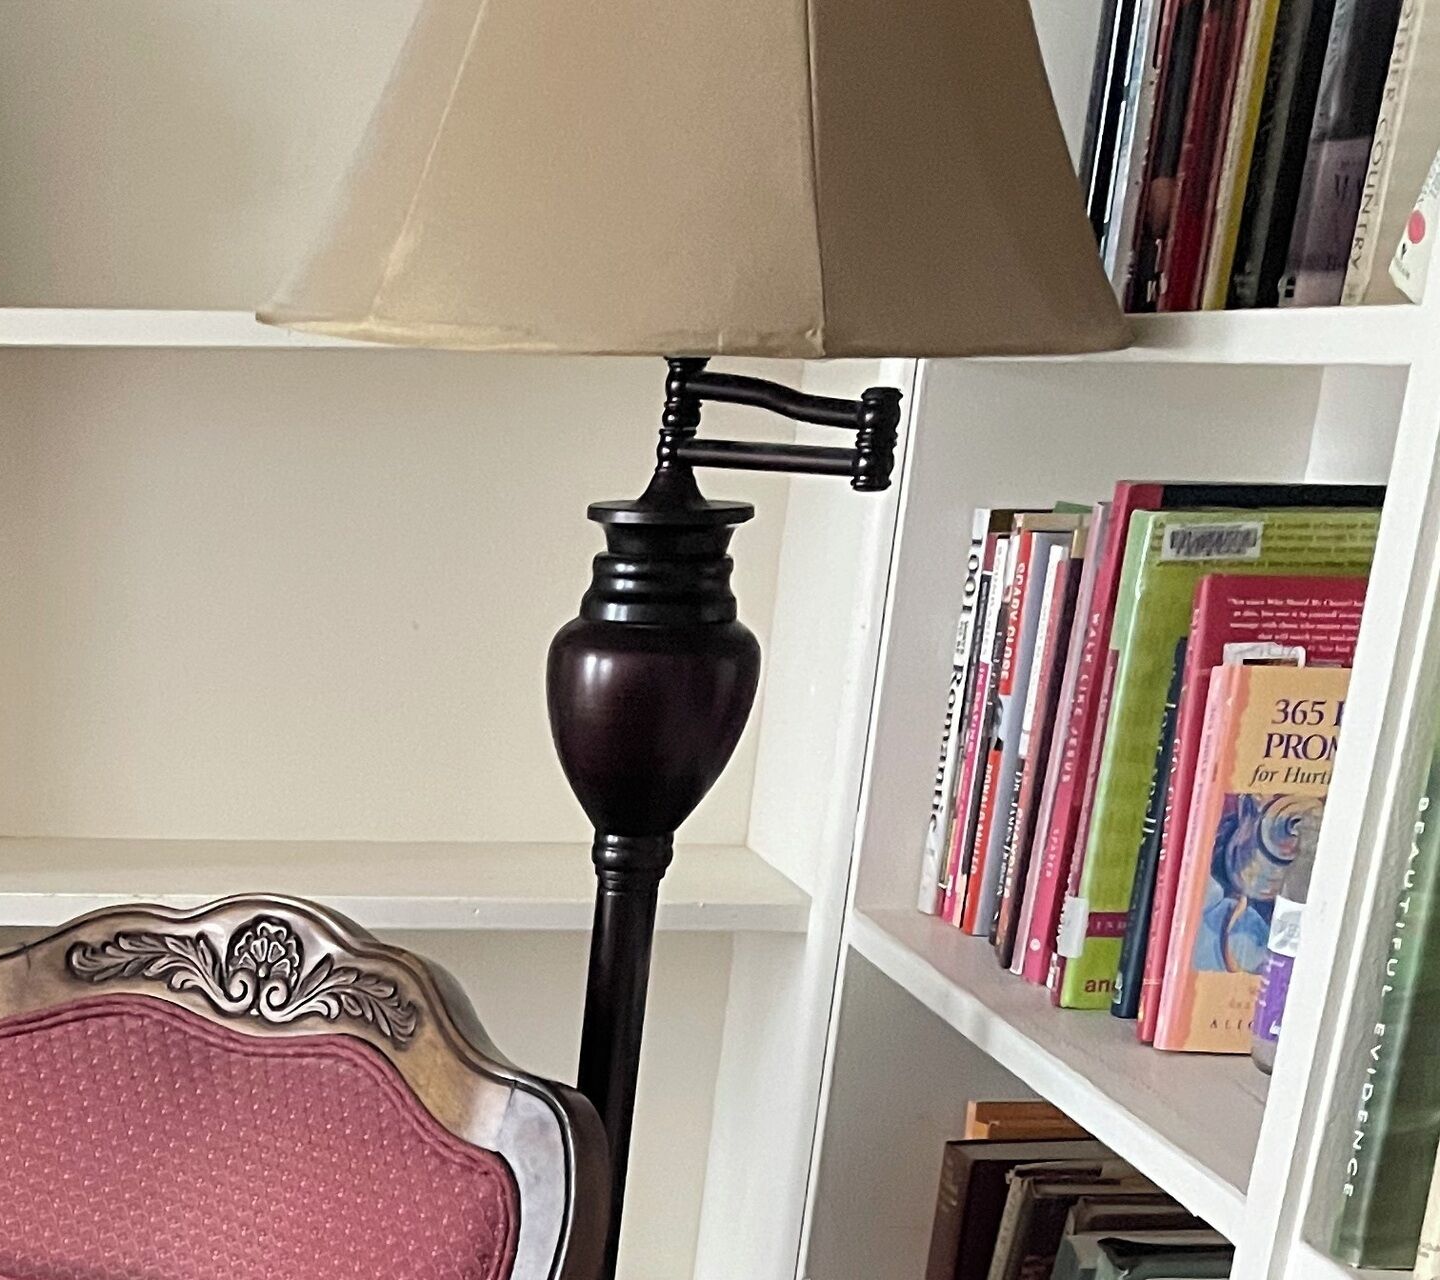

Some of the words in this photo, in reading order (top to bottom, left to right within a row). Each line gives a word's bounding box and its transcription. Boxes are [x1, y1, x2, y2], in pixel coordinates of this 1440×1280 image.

[1346, 117, 1392, 271] COUNTRY
[962, 539, 983, 611] 1001
[1084, 613, 1100, 663] WALK
[1073, 673, 1090, 716] LIKE
[1270, 700, 1325, 727] 365
[930, 663, 964, 833] Romantic
[1061, 727, 1079, 783] JESUS
[1248, 764, 1281, 789] for
[1380, 796, 1431, 999] BEAUTIFUL
[1342, 1022, 1386, 1199] EVIDENCE
